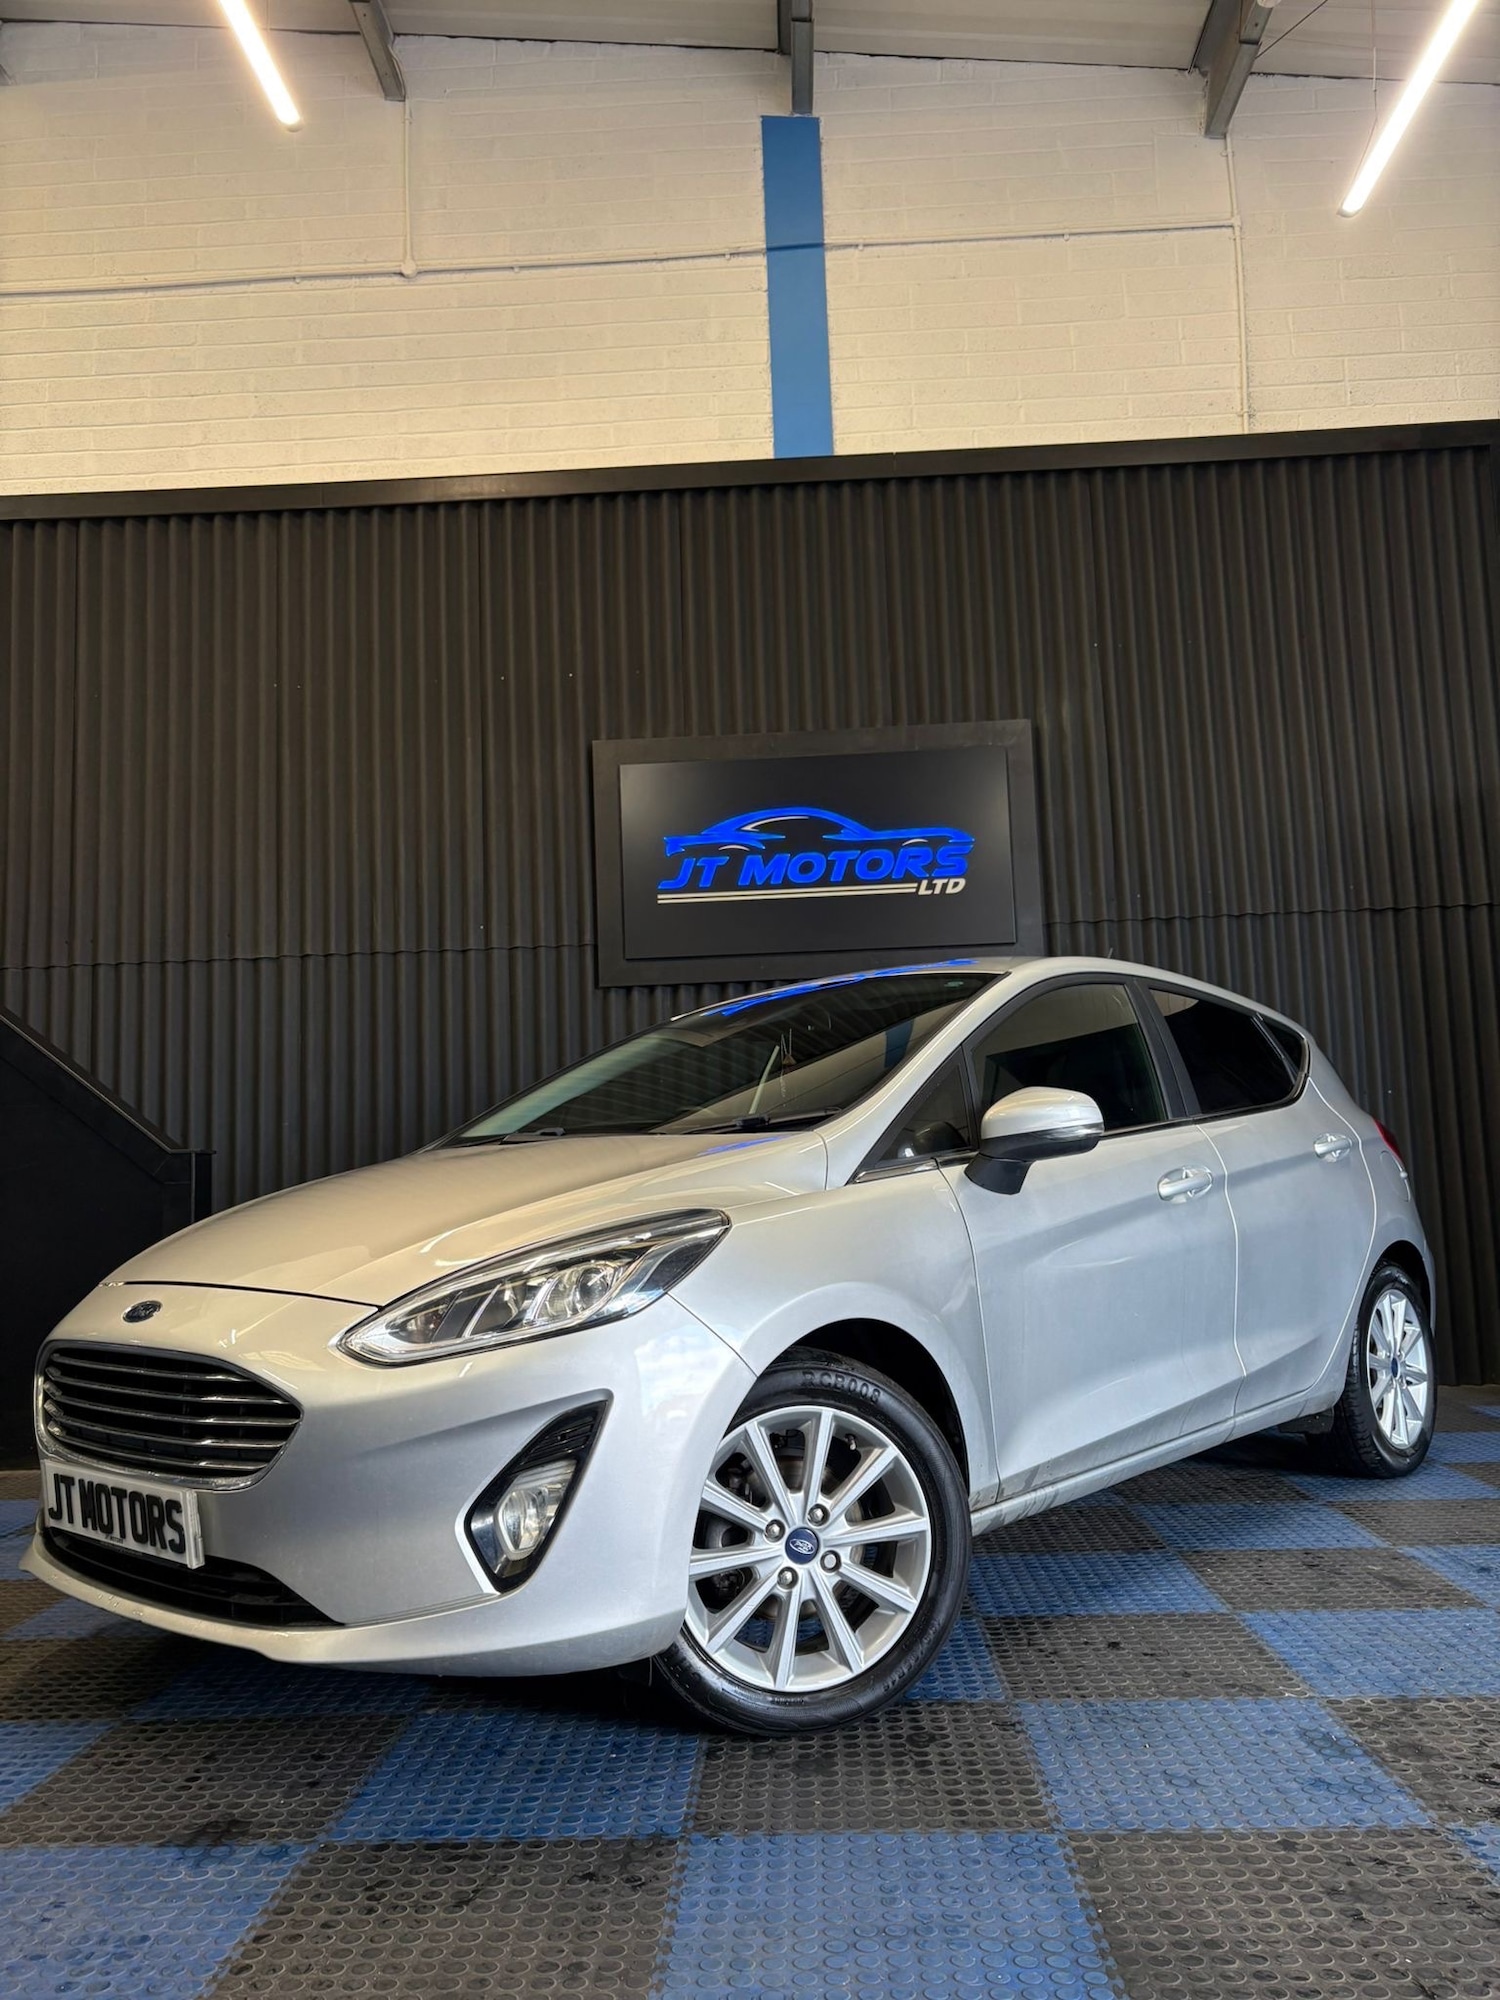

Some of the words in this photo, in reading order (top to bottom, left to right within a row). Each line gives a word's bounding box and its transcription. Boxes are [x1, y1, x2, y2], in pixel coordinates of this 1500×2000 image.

[658, 855, 729, 890] JT
[738, 844, 975, 886] MOTORS
[917, 877, 967, 896] LTD
[47, 1473, 75, 1525] JT
[78, 1478, 187, 1555] MOTORS
